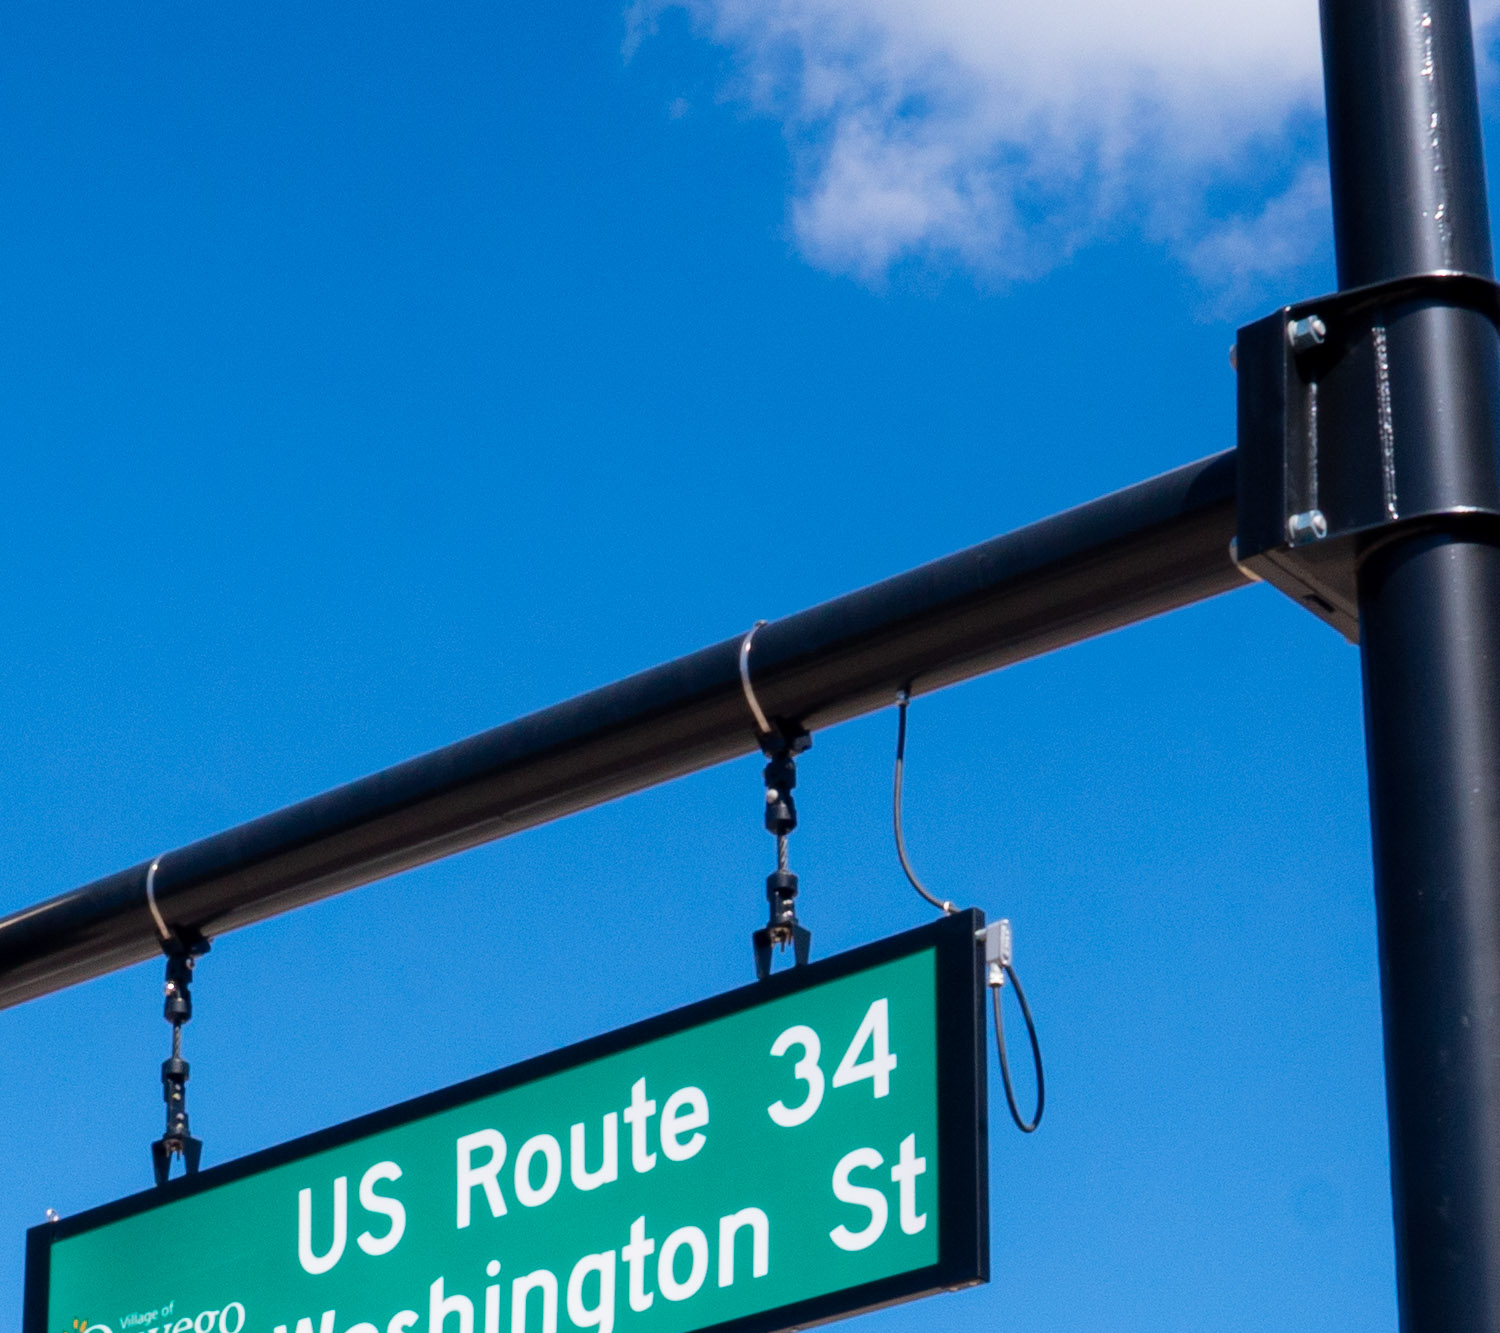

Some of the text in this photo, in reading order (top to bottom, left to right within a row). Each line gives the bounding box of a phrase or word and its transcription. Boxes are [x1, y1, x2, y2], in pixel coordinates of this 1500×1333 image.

[298, 998, 897, 1274] US Route 34
[829, 1133, 927, 1251] St
[119, 1300, 174, 1330] Village of
